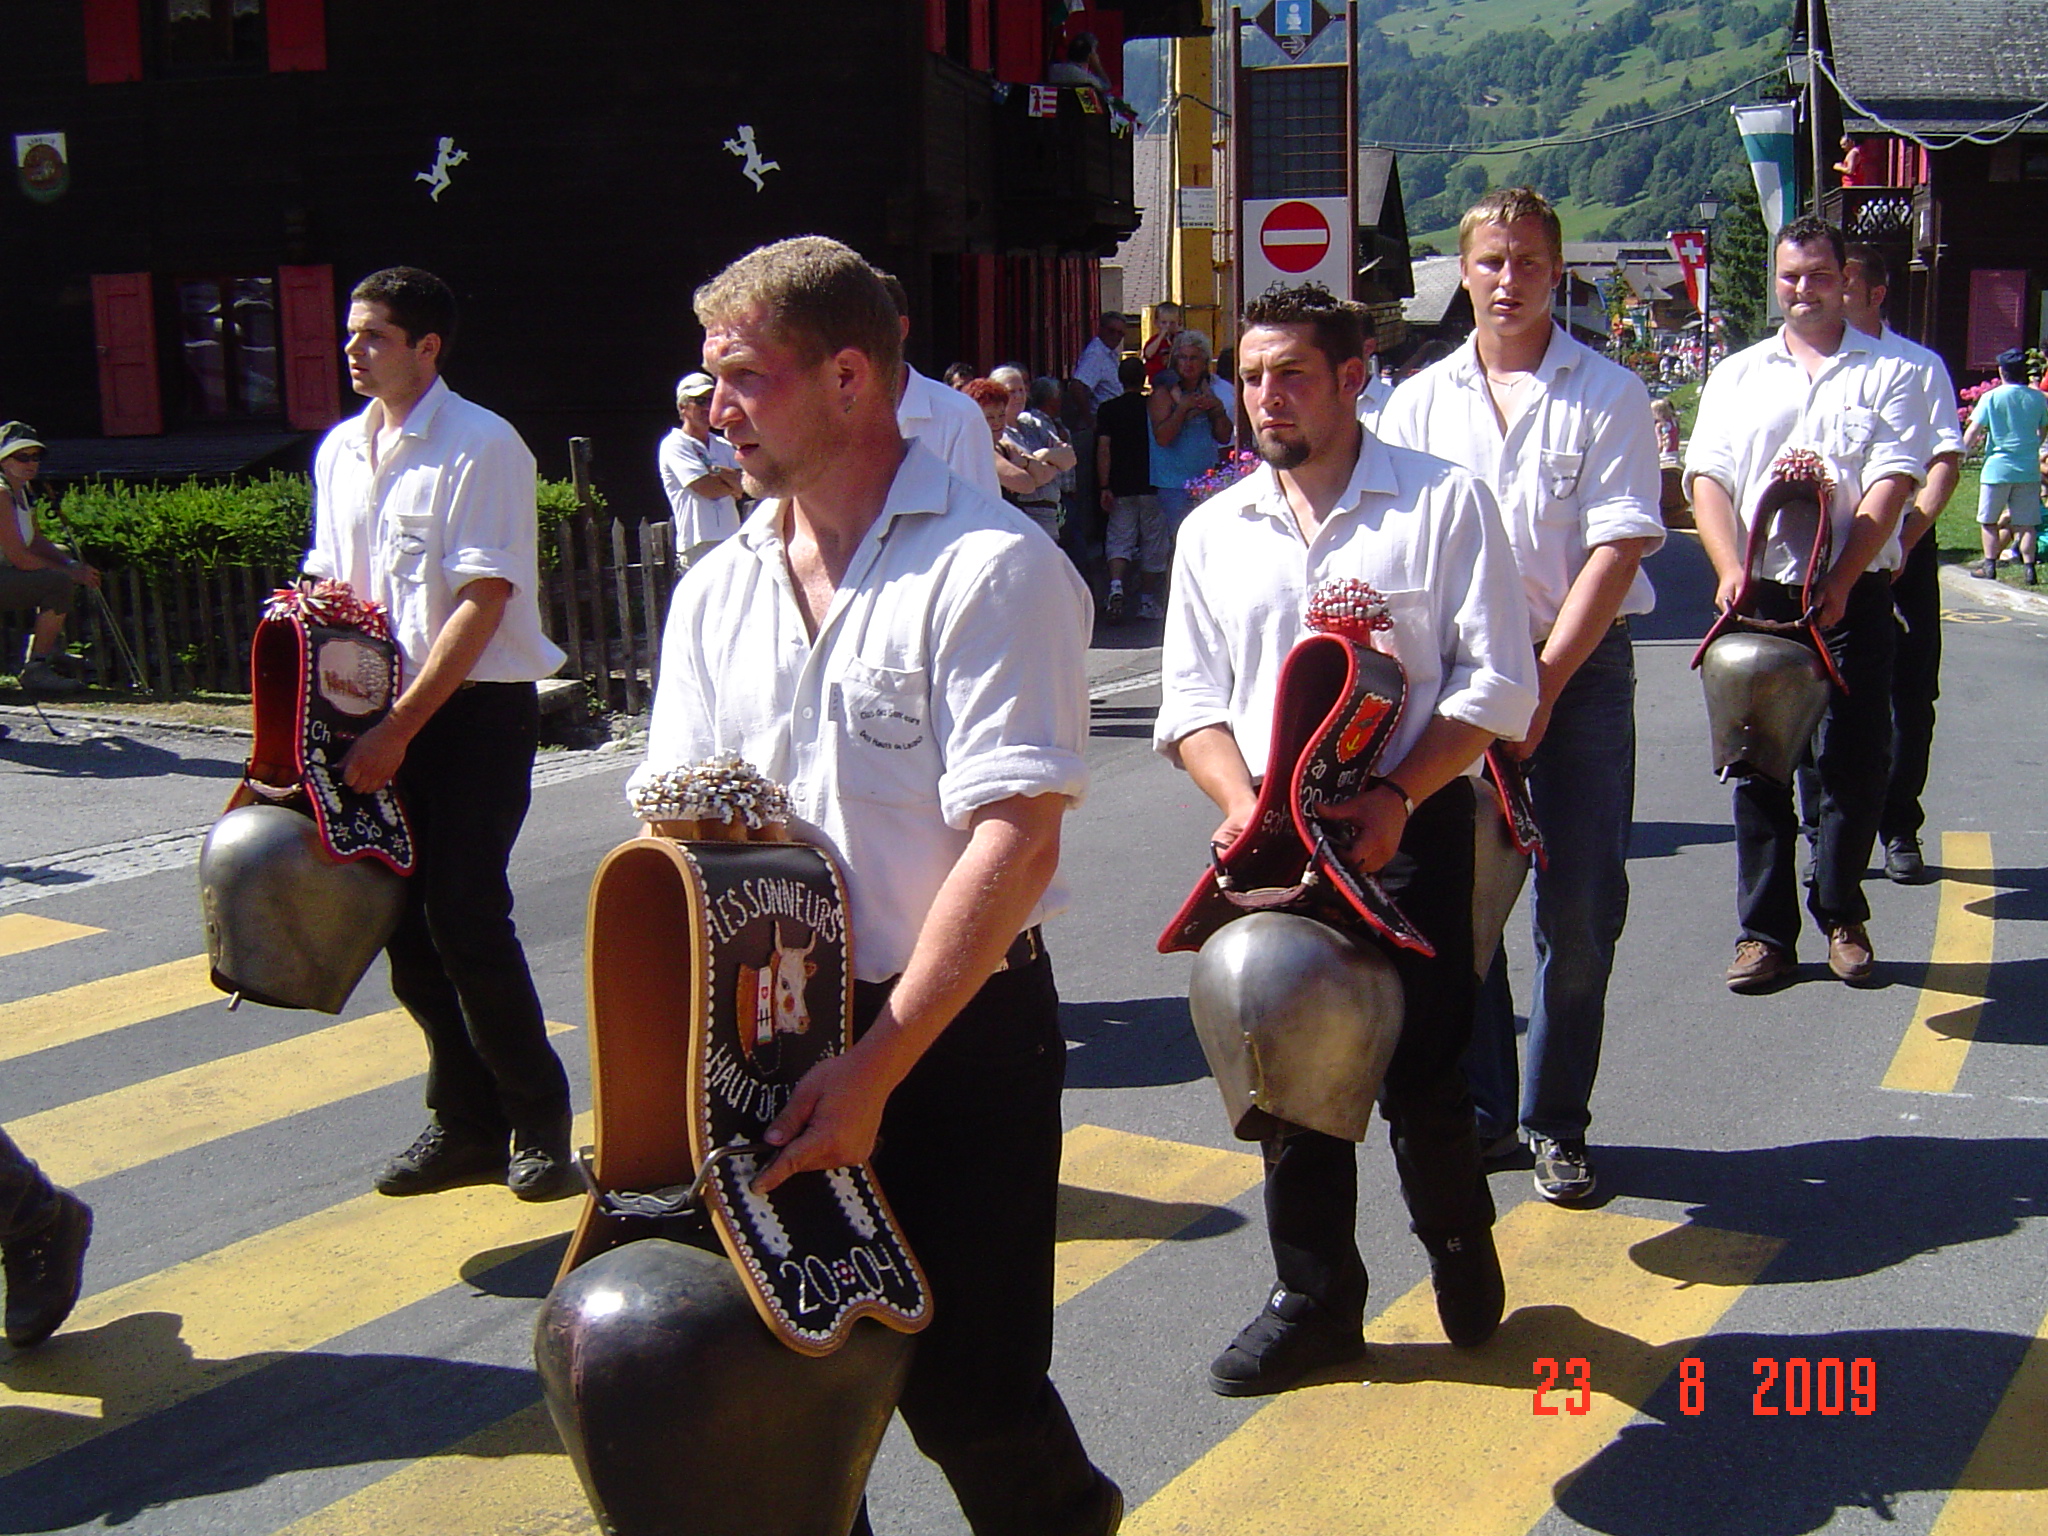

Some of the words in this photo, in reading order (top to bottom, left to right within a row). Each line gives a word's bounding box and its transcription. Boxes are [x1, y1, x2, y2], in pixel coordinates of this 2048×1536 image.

[710, 888, 748, 944] LES
[743, 877, 840, 943] SONNEURS
[710, 1042, 759, 1114] HAUT
